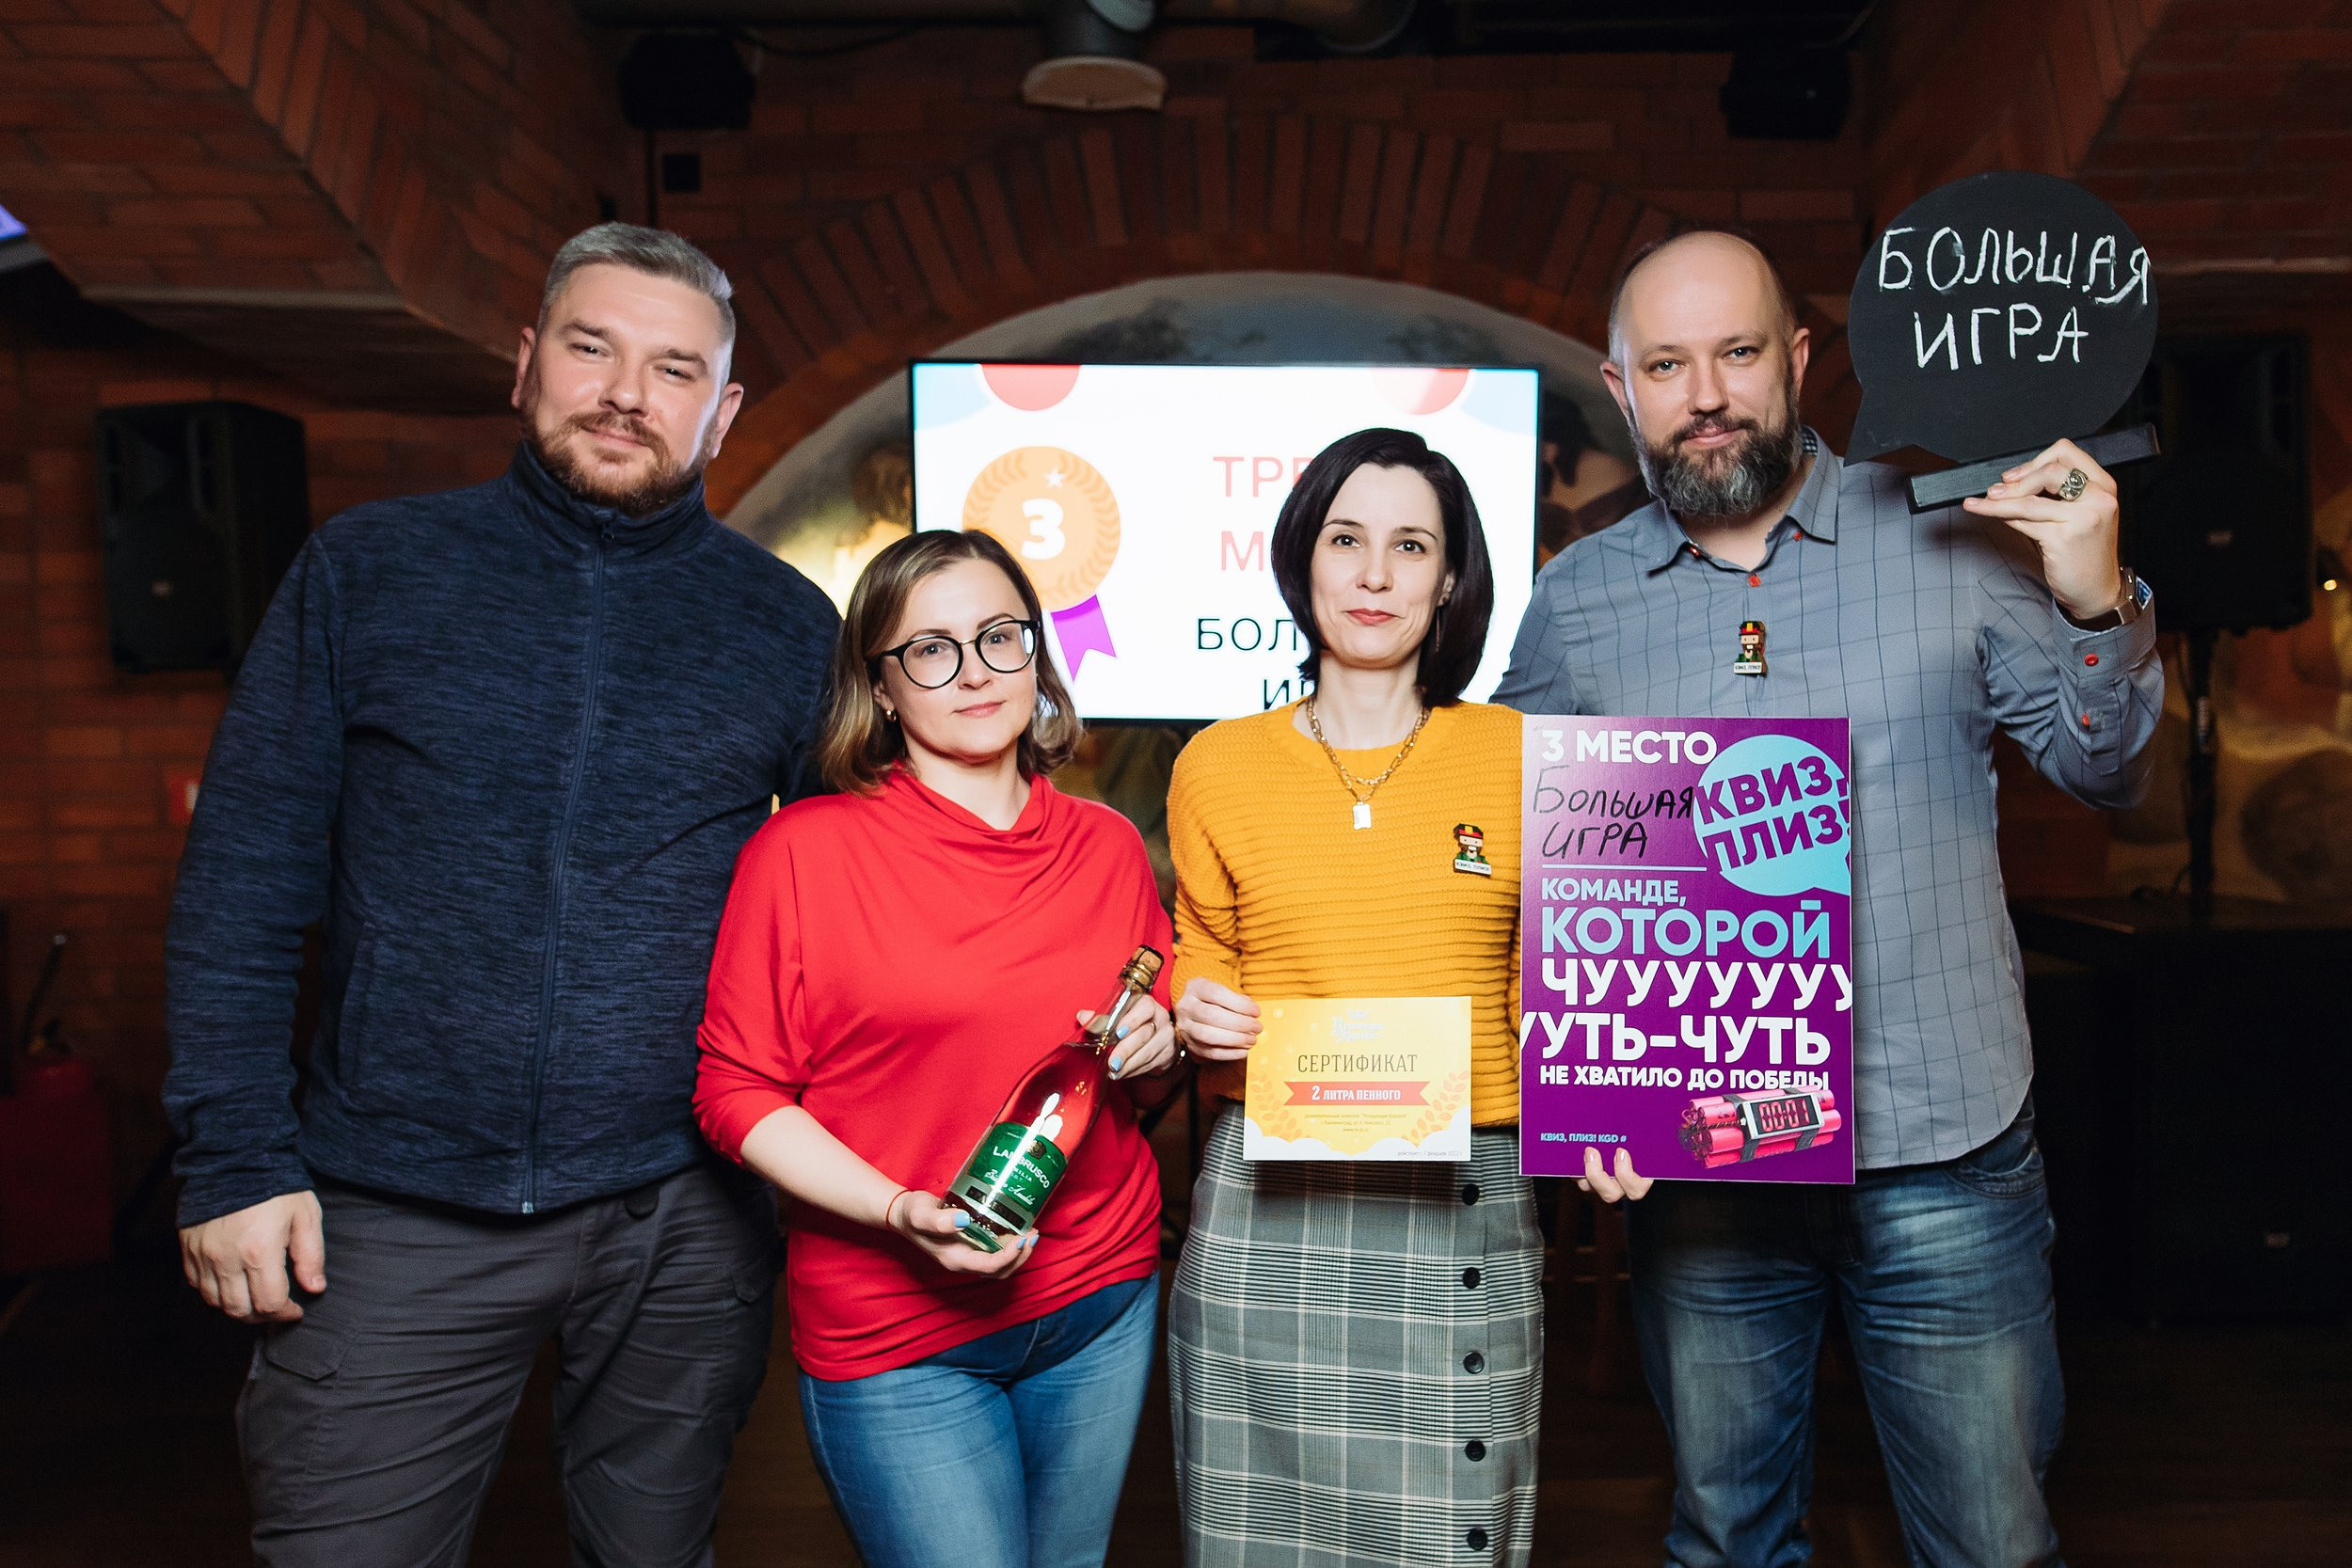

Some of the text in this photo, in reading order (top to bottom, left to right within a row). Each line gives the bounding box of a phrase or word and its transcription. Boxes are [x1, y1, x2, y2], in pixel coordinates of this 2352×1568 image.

[1878, 227, 2152, 305] БОЛЬШАЯ
[1913, 302, 2090, 371] ИГРА
[1021, 498, 1065, 561] 3
[1541, 730, 1718, 765] 3 МЕСТО
[1541, 878, 1686, 908] КОМАНДЕ,
[1541, 900, 1831, 958] КОТОРОЙ
[1297, 1053, 1418, 1073] СЕРТИФИКАТ
[1540, 1065, 1830, 1092] НЕ ХВАТИЛО ДО ПОБЕДЫ
[1311, 1085, 1401, 1101] 2 ЛИТРА ПЕННОГО
[1540, 1132, 1567, 1143] КВИЗ,
[1568, 1132, 1597, 1142] ПЛИЗ!
[1597, 1133, 1618, 1143] KGD
[993, 1146, 1050, 1188] LABRUSCO
